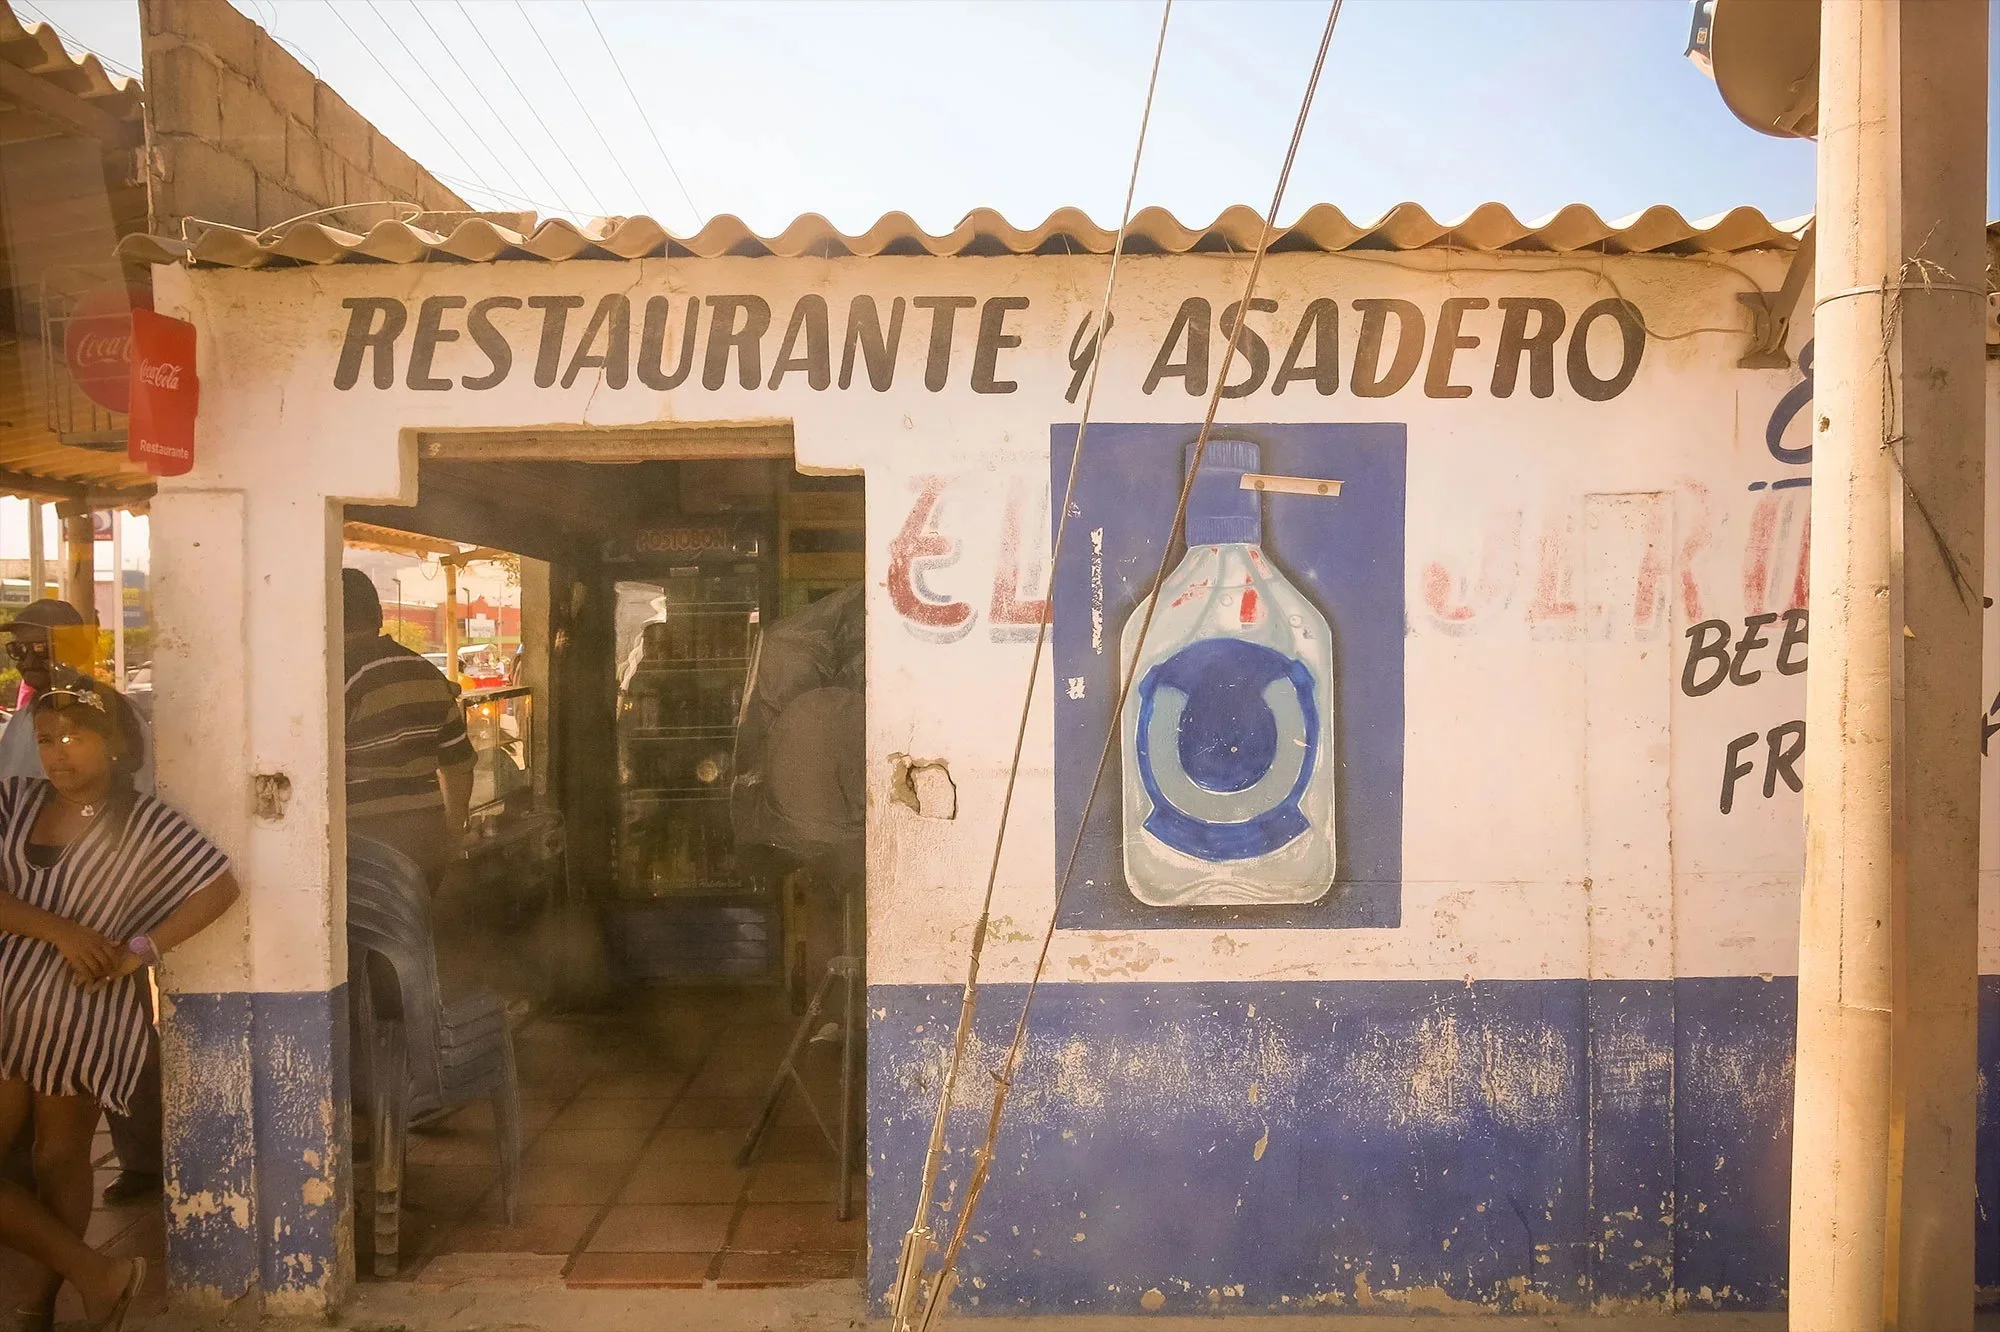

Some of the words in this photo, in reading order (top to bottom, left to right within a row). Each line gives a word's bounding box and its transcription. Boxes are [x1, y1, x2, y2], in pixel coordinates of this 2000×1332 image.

[333, 292, 1029, 394] RESTAURANTE
[1141, 296, 1647, 402] ASADERO
[139, 439, 190, 460] Restaurante
[1681, 608, 1809, 698] BEB
[1719, 719, 1806, 815] FR
